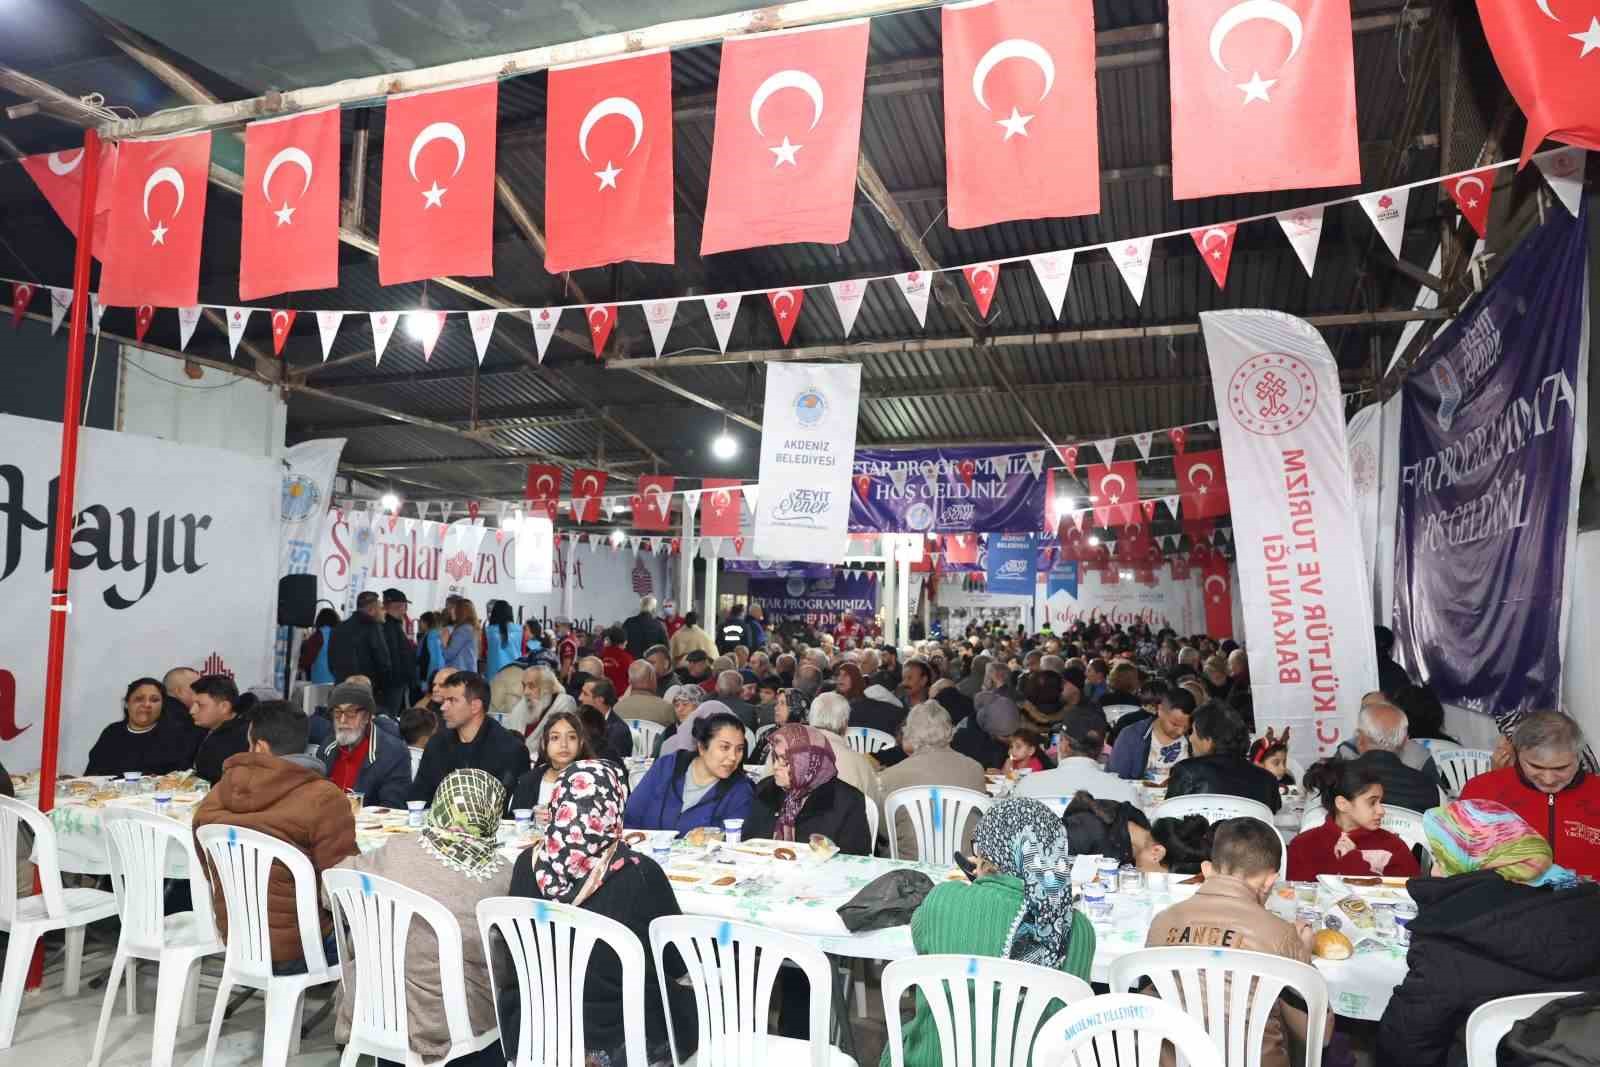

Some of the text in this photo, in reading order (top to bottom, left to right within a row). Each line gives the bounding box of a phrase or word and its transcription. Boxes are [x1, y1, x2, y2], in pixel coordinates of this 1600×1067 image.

[784, 439, 830, 451] AKDENİZ
[854, 460, 892, 477] TAR
[794, 488, 832, 502] ZEYİT
